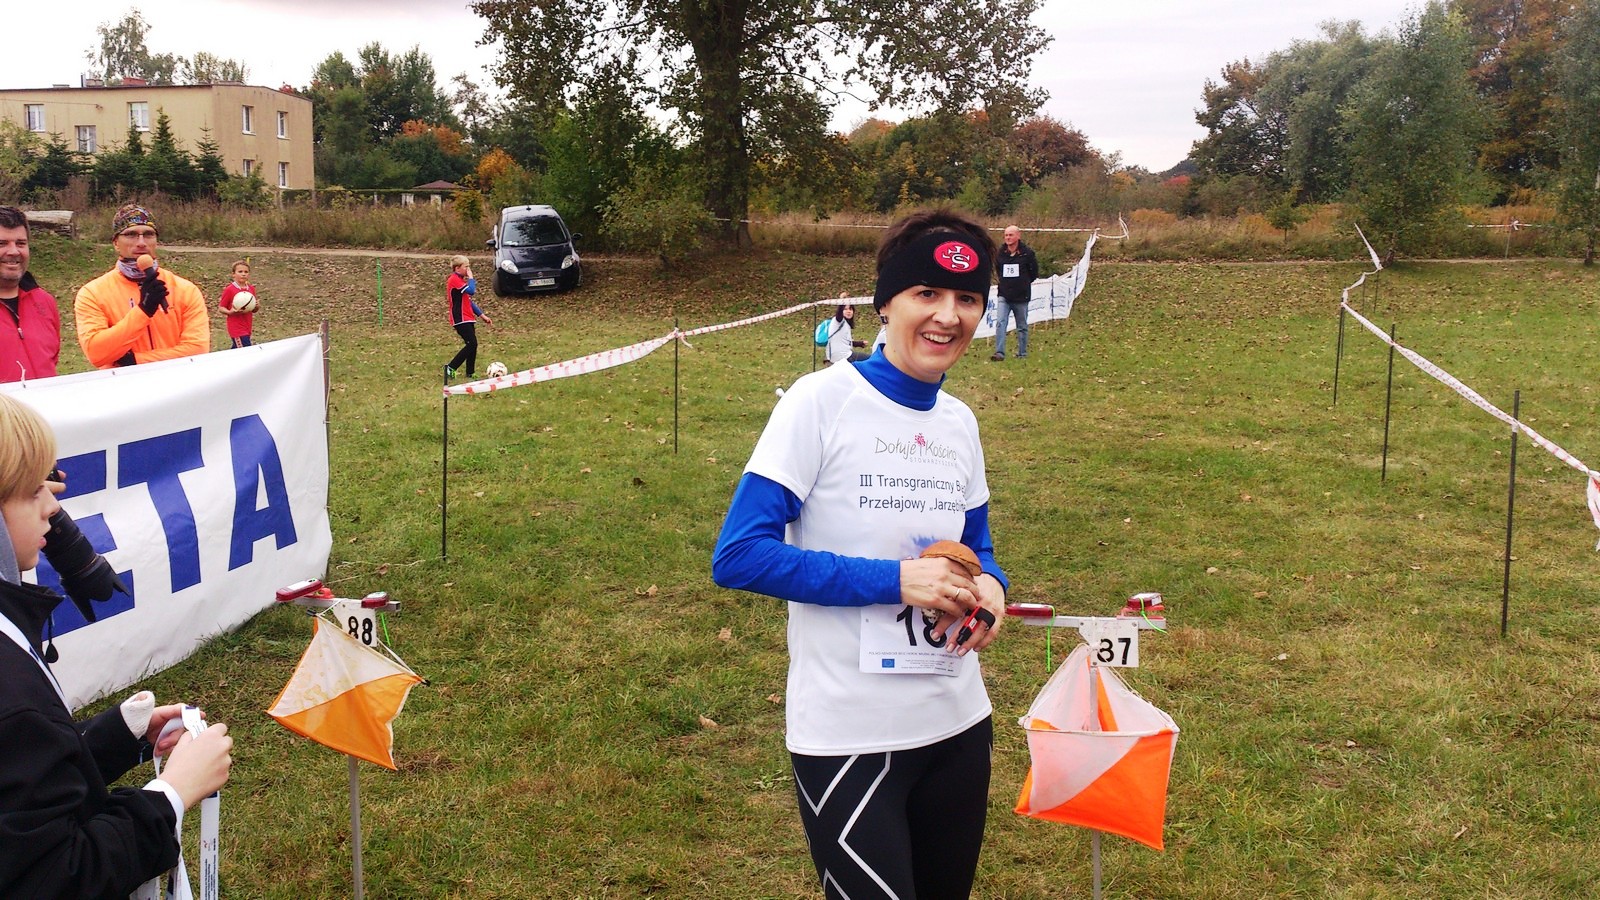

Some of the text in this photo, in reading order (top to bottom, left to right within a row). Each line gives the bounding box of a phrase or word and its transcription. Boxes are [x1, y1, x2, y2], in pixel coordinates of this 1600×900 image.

[874, 436, 917, 460] Dołuje
[859, 474, 873, 487] III
[876, 474, 955, 494] Transgraniczny
[859, 495, 926, 513] Przełajowy
[348, 615, 373, 646] 88
[896, 605, 948, 648] 18
[1096, 637, 1132, 665] 87
